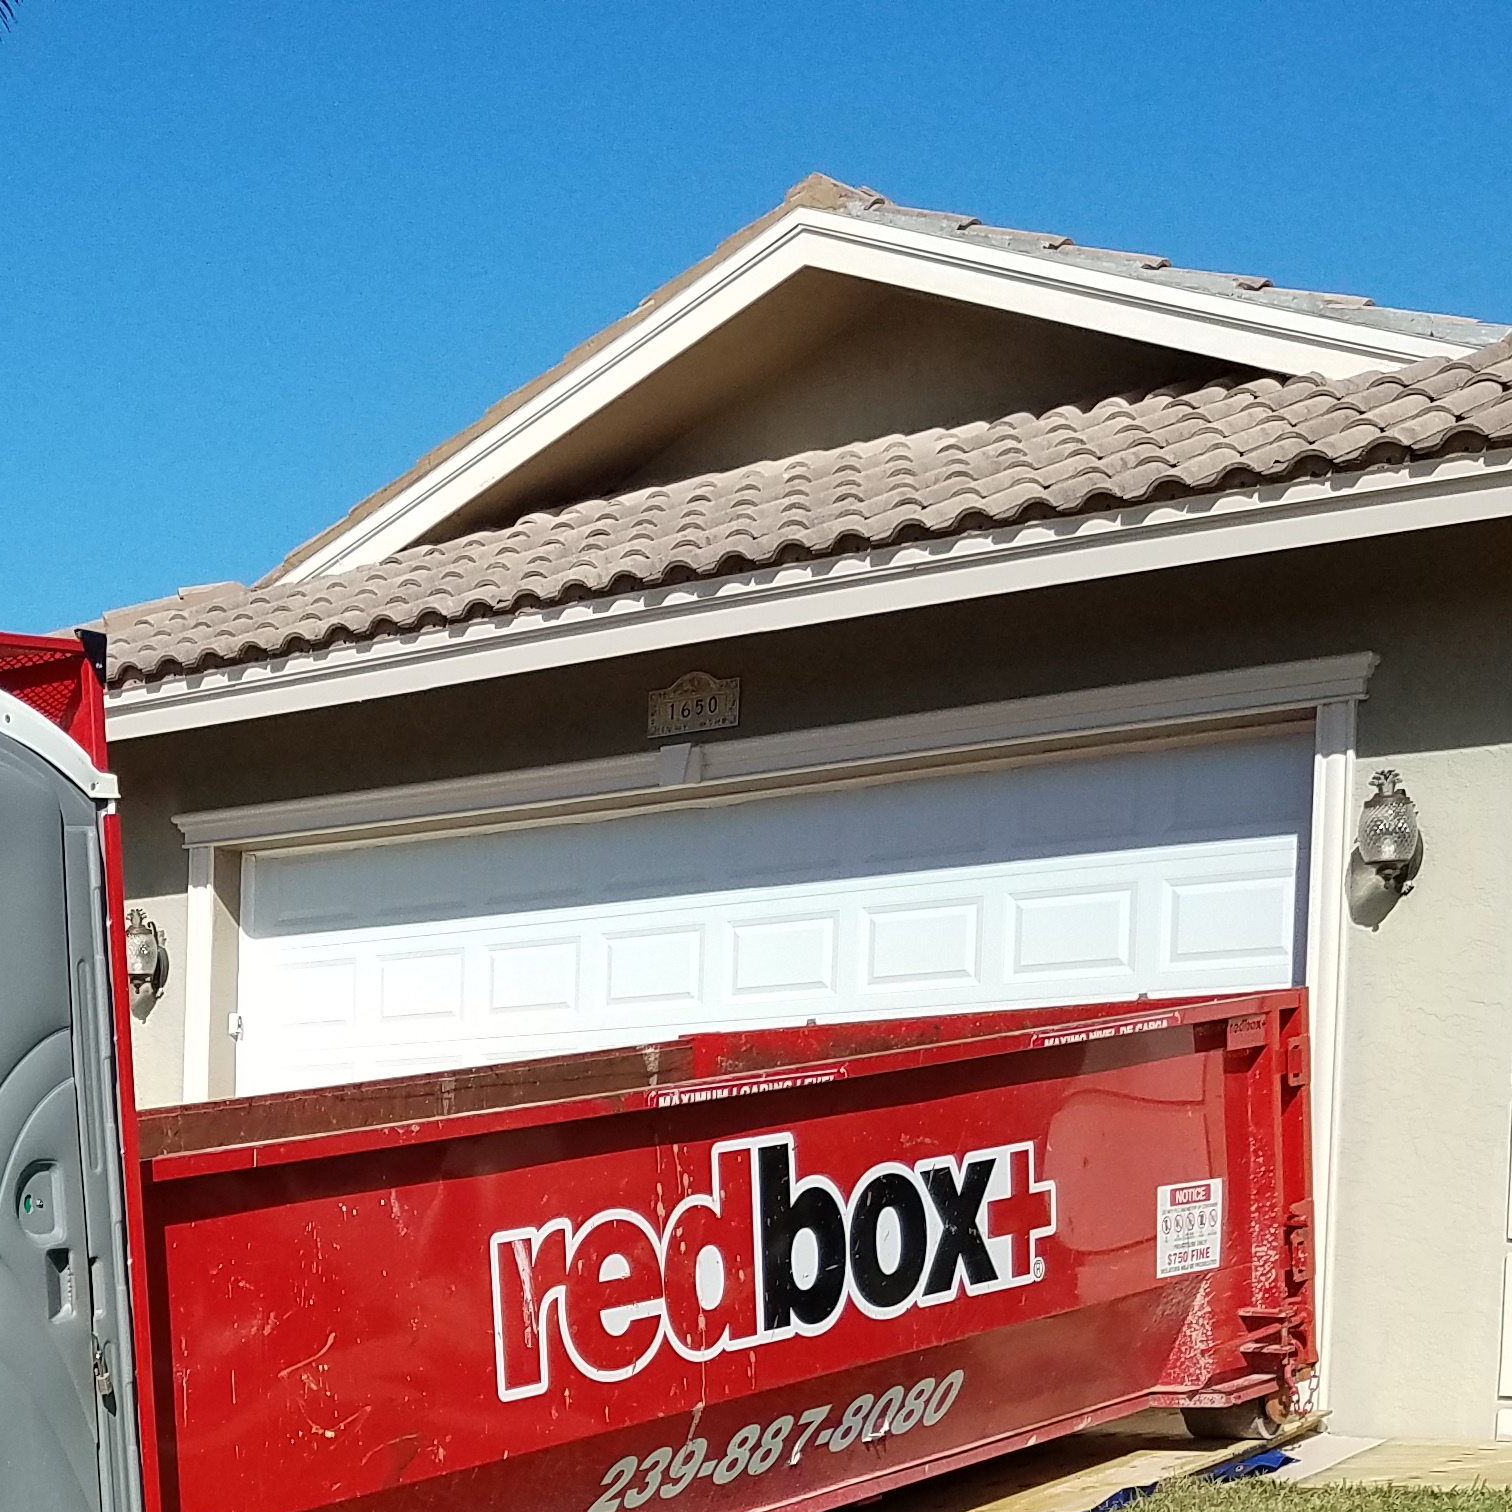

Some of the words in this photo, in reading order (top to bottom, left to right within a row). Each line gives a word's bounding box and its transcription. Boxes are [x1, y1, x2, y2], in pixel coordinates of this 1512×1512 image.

[669, 696, 718, 720] 1650
[1175, 1187, 1206, 1204] NOTICE
[1167, 1251, 1188, 1266] $750
[1191, 1247, 1210, 1260] FINE
